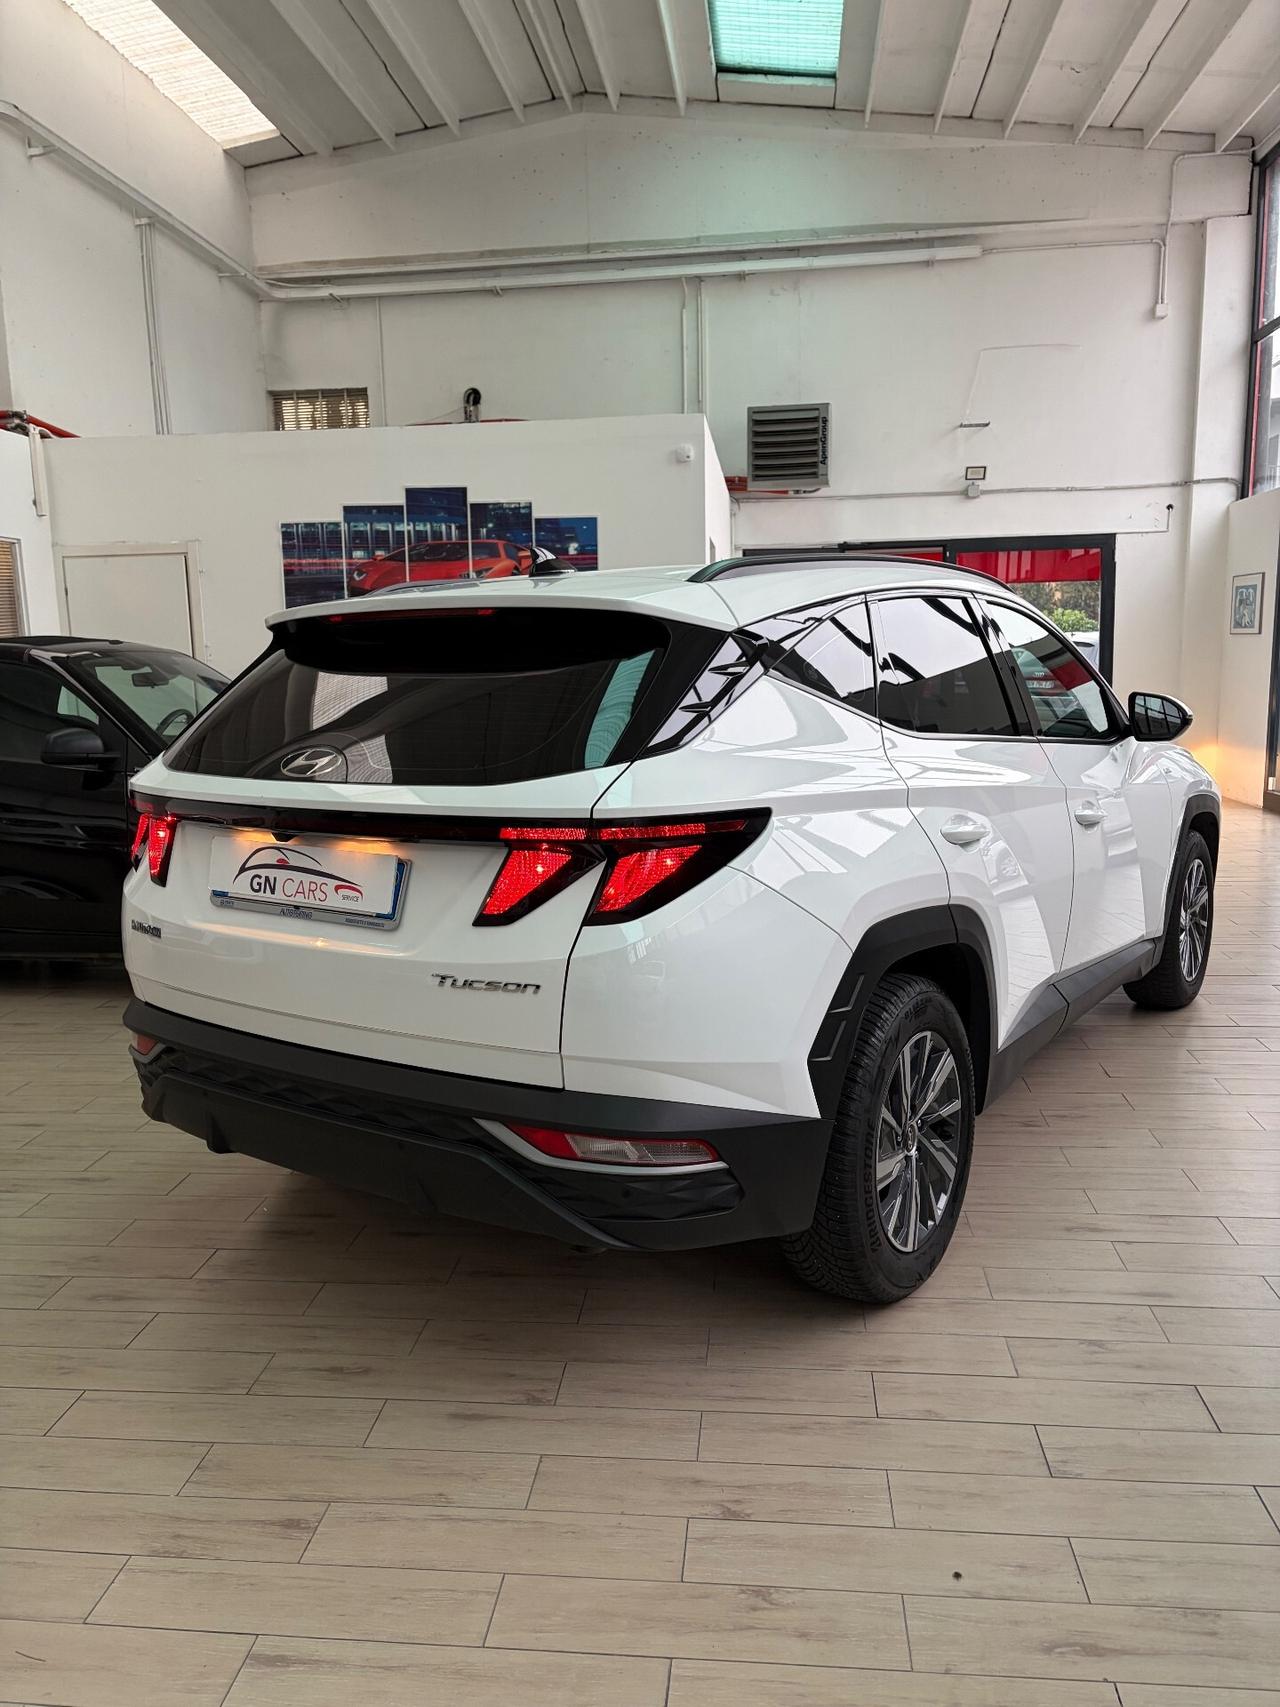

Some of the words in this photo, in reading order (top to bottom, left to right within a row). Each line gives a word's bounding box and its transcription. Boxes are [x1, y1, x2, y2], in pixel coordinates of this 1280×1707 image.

[820, 416, 828, 465] ApenGroup
[249, 873, 277, 895] GN
[281, 877, 329, 903] CARS
[341, 894, 360, 903] SERVICE
